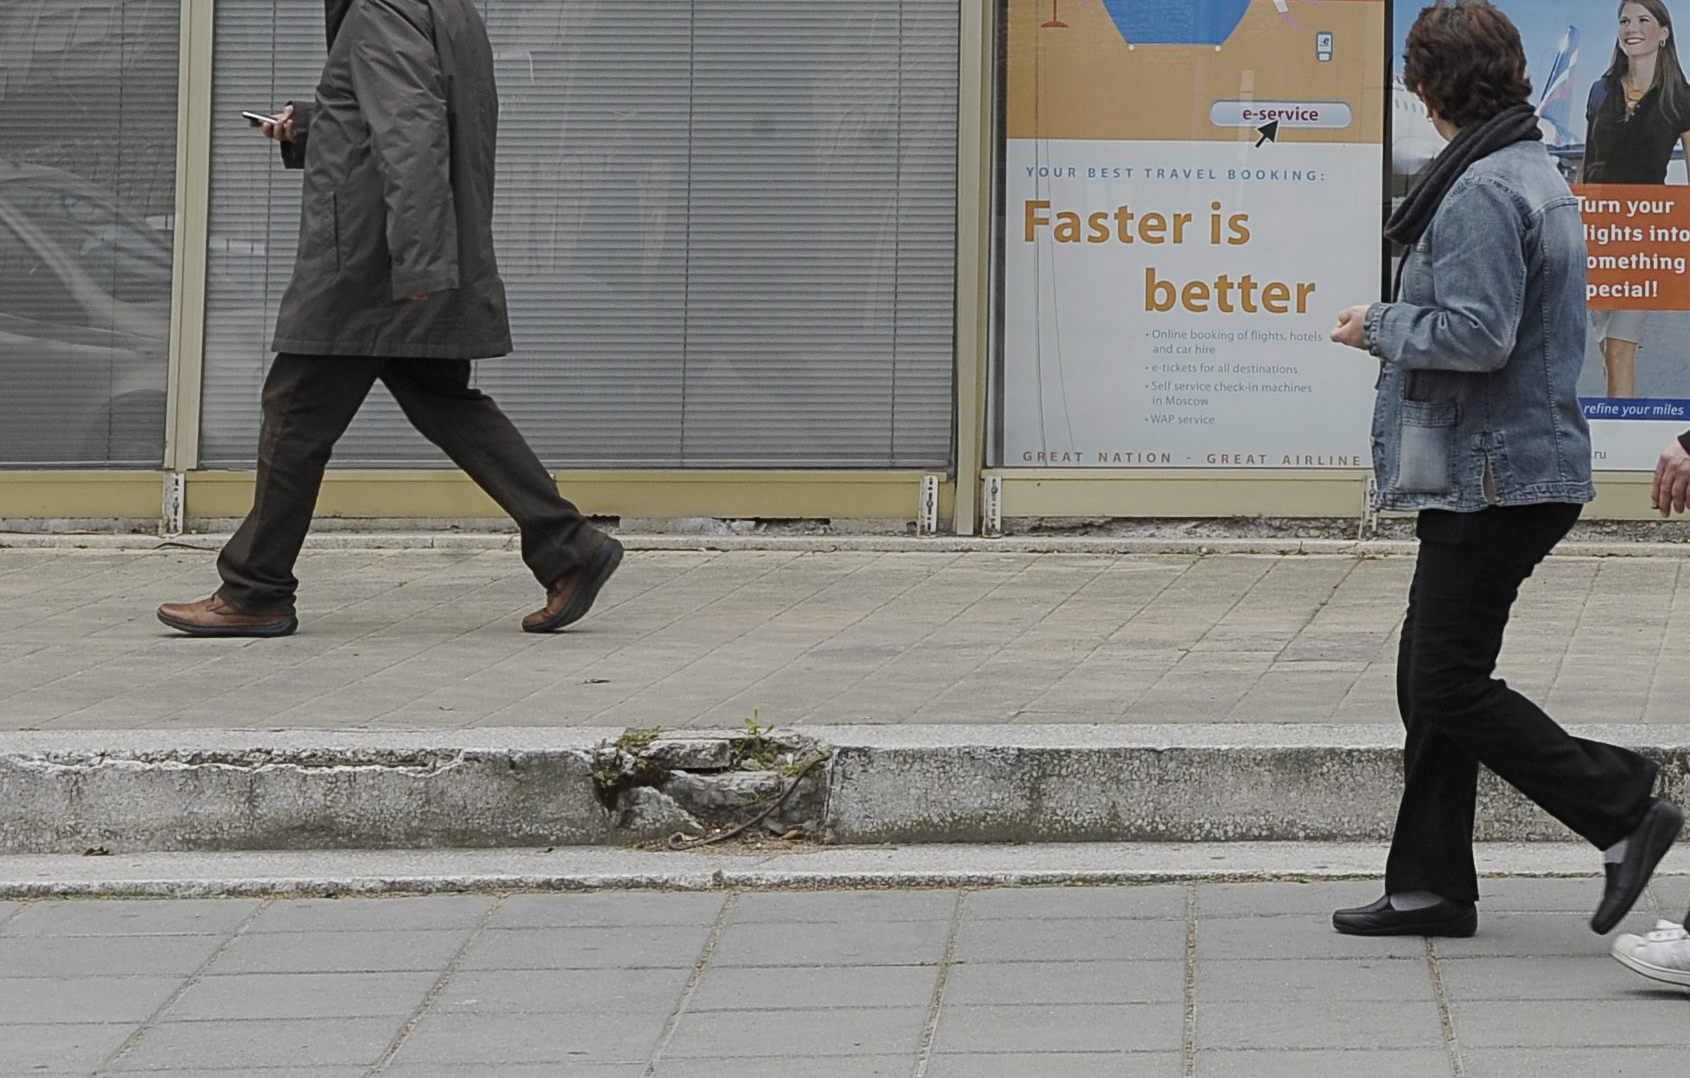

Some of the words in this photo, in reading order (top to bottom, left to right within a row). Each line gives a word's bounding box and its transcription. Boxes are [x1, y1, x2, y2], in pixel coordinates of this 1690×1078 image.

[1242, 106, 1319, 121] e-service
[1026, 166, 1076, 178] YOUR
[1088, 167, 1133, 179] BEST
[1144, 168, 1216, 180] TRAVEL
[1228, 169, 1325, 181] BOOKING:
[1573, 195, 1621, 213] Turn
[1626, 199, 1675, 217] your
[1024, 200, 1192, 245] Faster
[1209, 201, 1252, 246] is
[1583, 223, 1643, 245] lights
[1649, 224, 1690, 242] into
[1586, 251, 1686, 274] omething
[1144, 267, 1316, 314] better
[1585, 280, 1658, 301] pecial!
[1152, 329, 1187, 340] Online
[1190, 329, 1235, 342] booking
[1237, 329, 1248, 340] of
[1250, 330, 1288, 343] flights,
[1289, 330, 1323, 342] hotels
[1152, 343, 1174, 354] and
[1176, 346, 1192, 355] car
[1195, 344, 1216, 355] hire
[1151, 362, 1197, 373] e-tickets
[1199, 362, 1215, 373] for
[1217, 362, 1230, 373] all
[1232, 363, 1299, 374] destinations
[1151, 380, 1172, 391] Self
[1174, 382, 1211, 392] service
[1213, 381, 1259, 392] check-in
[1261, 382, 1312, 394] machines
[1152, 395, 1162, 405] in
[1165, 395, 1209, 406] Moscow
[1583, 402, 1619, 415] refine
[1620, 404, 1650, 417] your
[1652, 403, 1685, 416] miles
[1150, 414, 1175, 424] WAP
[1178, 415, 1215, 425] service
[1022, 451, 1084, 463] GREAT
[1098, 451, 1172, 464] NATION
[1206, 453, 1268, 465] GREAT
[1282, 454, 1361, 467] AIRLINE
